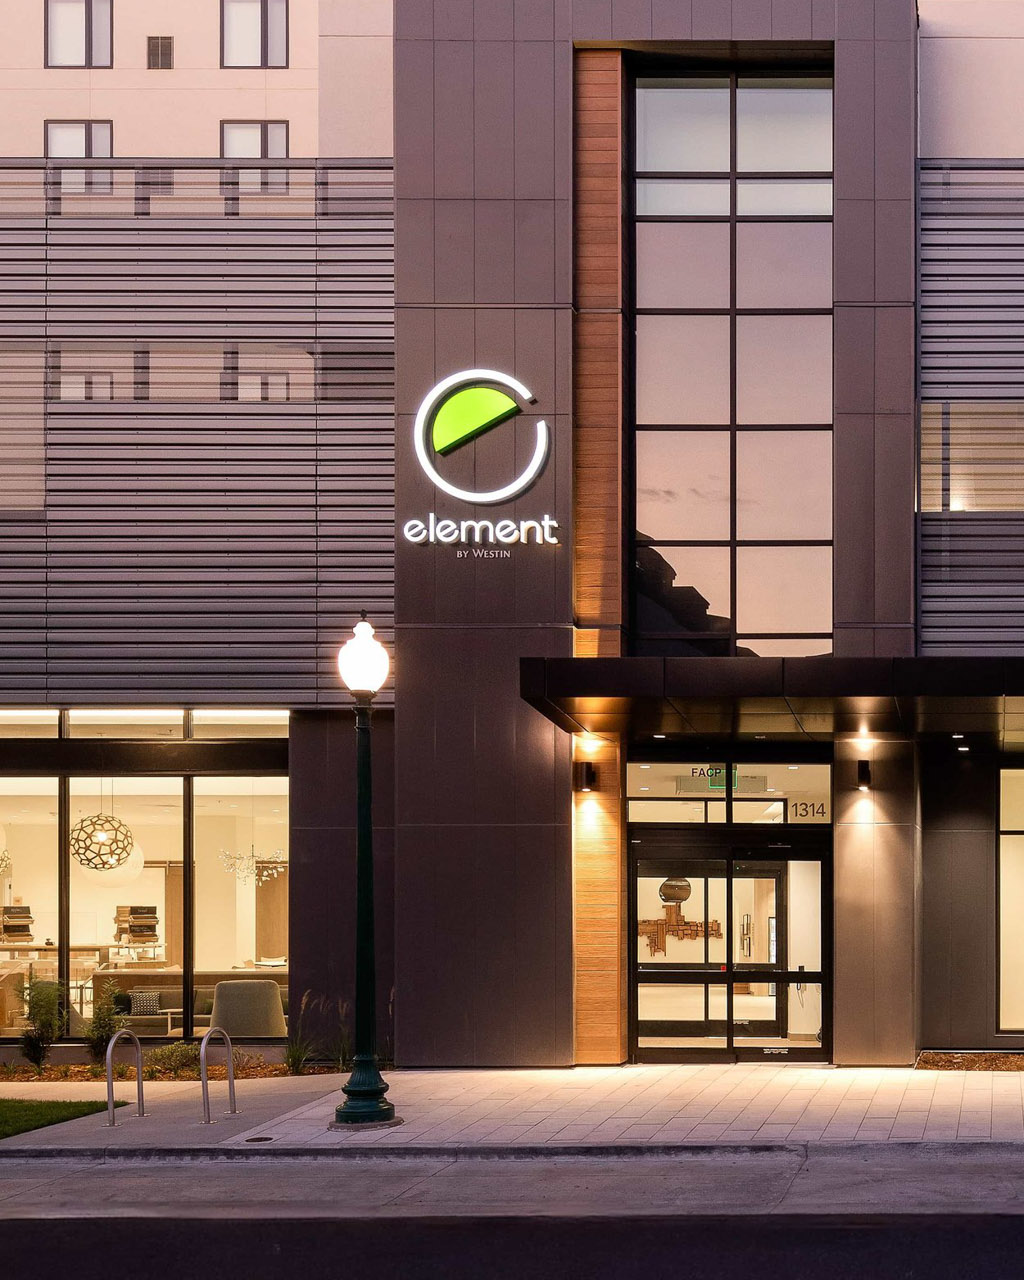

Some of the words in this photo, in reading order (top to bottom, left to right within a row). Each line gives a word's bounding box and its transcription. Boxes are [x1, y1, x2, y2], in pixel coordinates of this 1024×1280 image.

[403, 512, 559, 544] element
[456, 549, 469, 559] BY
[472, 548, 512, 559] WESTIN
[690, 767, 722, 778] FACP
[791, 802, 826, 818] 1314
